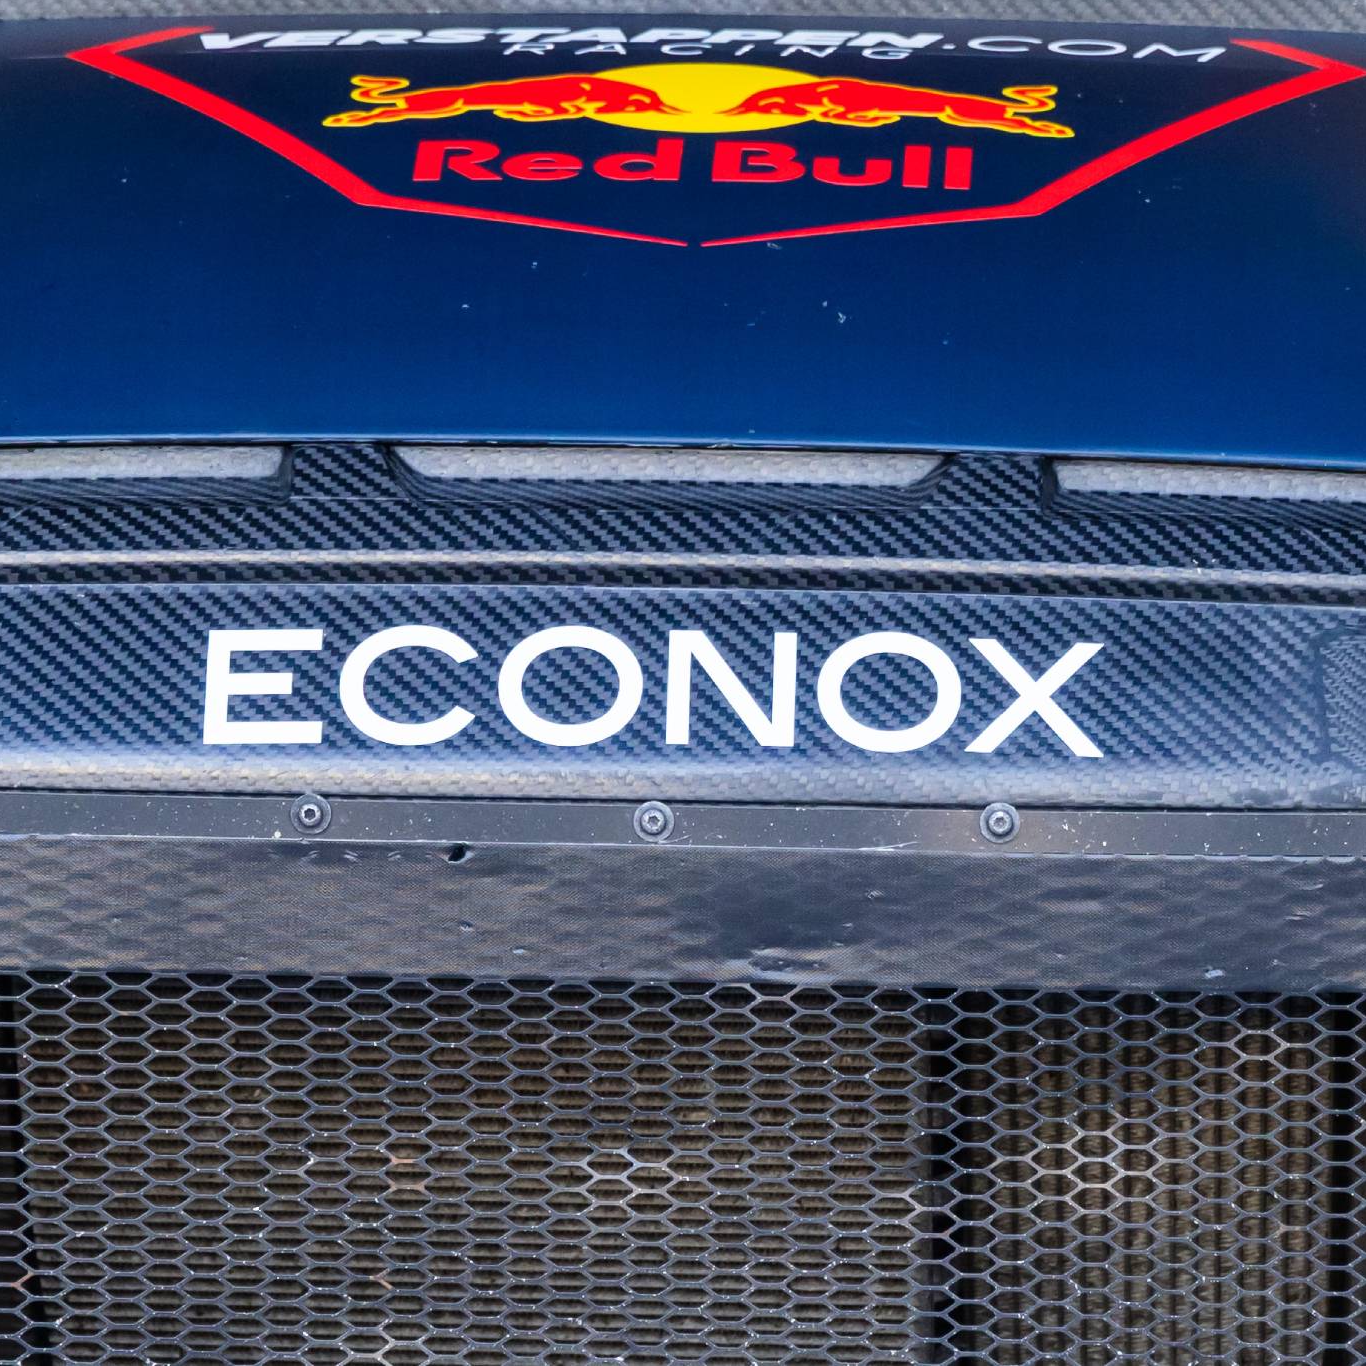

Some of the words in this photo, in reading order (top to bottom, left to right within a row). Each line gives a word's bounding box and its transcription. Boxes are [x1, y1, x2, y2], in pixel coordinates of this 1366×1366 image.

[200, 27, 1227, 63] VERSTAPPEN.COM
[503, 42, 913, 61] RACING
[412, 138, 684, 182] Red
[711, 140, 973, 190] Bull
[201, 623, 1106, 759] ECONOX
